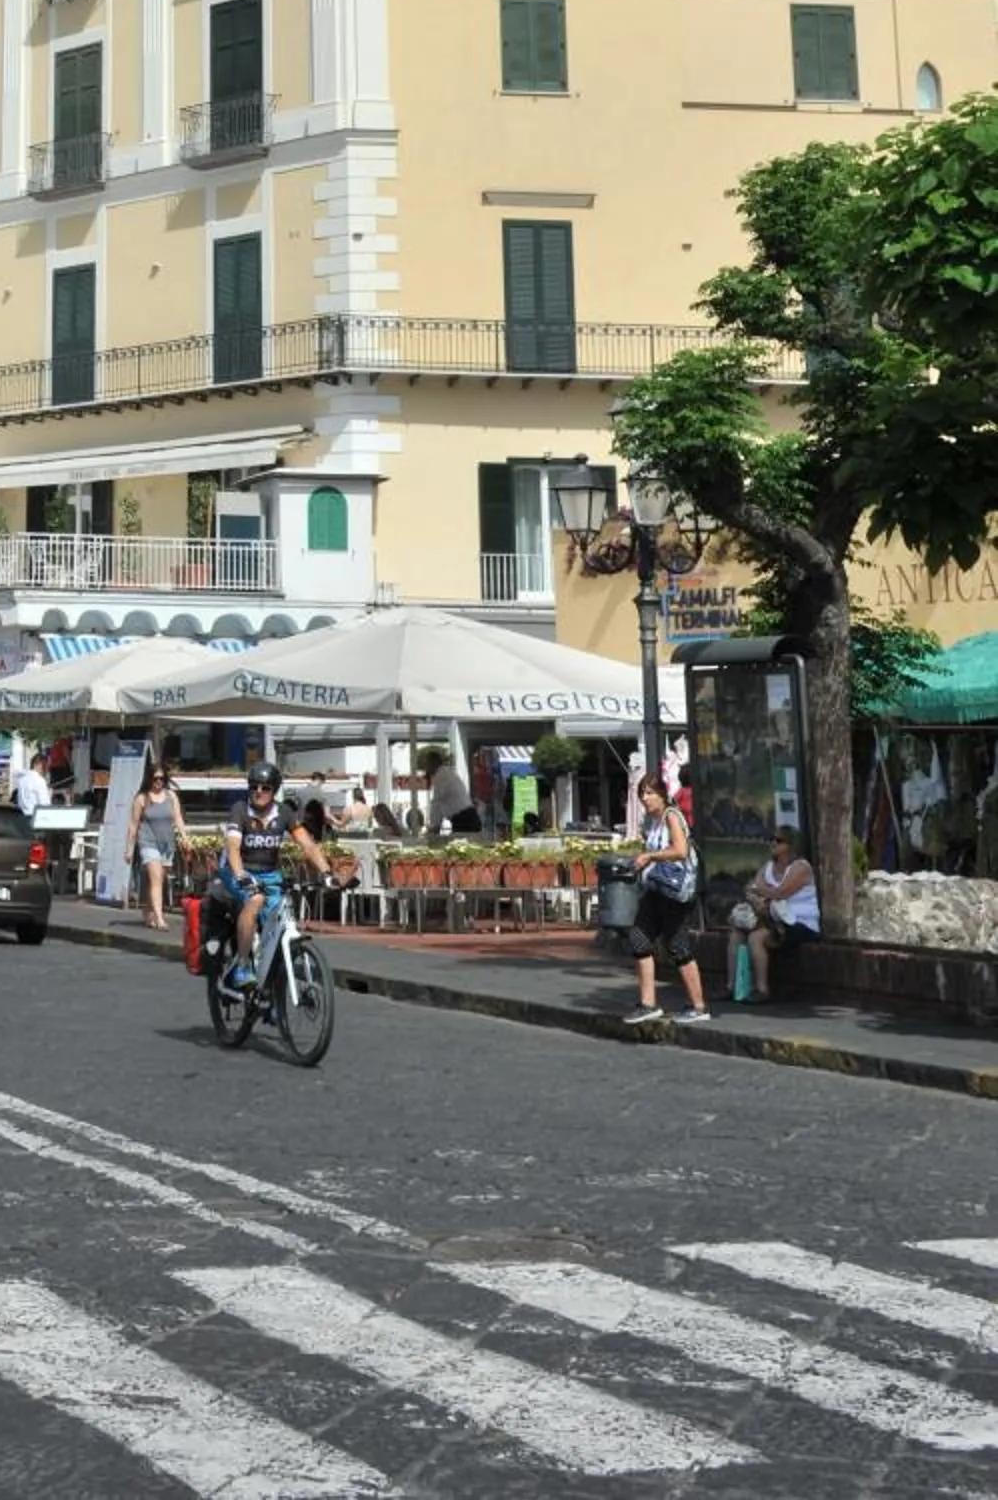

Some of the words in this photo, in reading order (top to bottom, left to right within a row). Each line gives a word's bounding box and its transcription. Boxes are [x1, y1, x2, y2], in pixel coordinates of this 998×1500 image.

[153, 686, 188, 707] BAR
[233, 673, 351, 706] GELATERIA
[466, 691, 678, 720] FRIGGITORA
